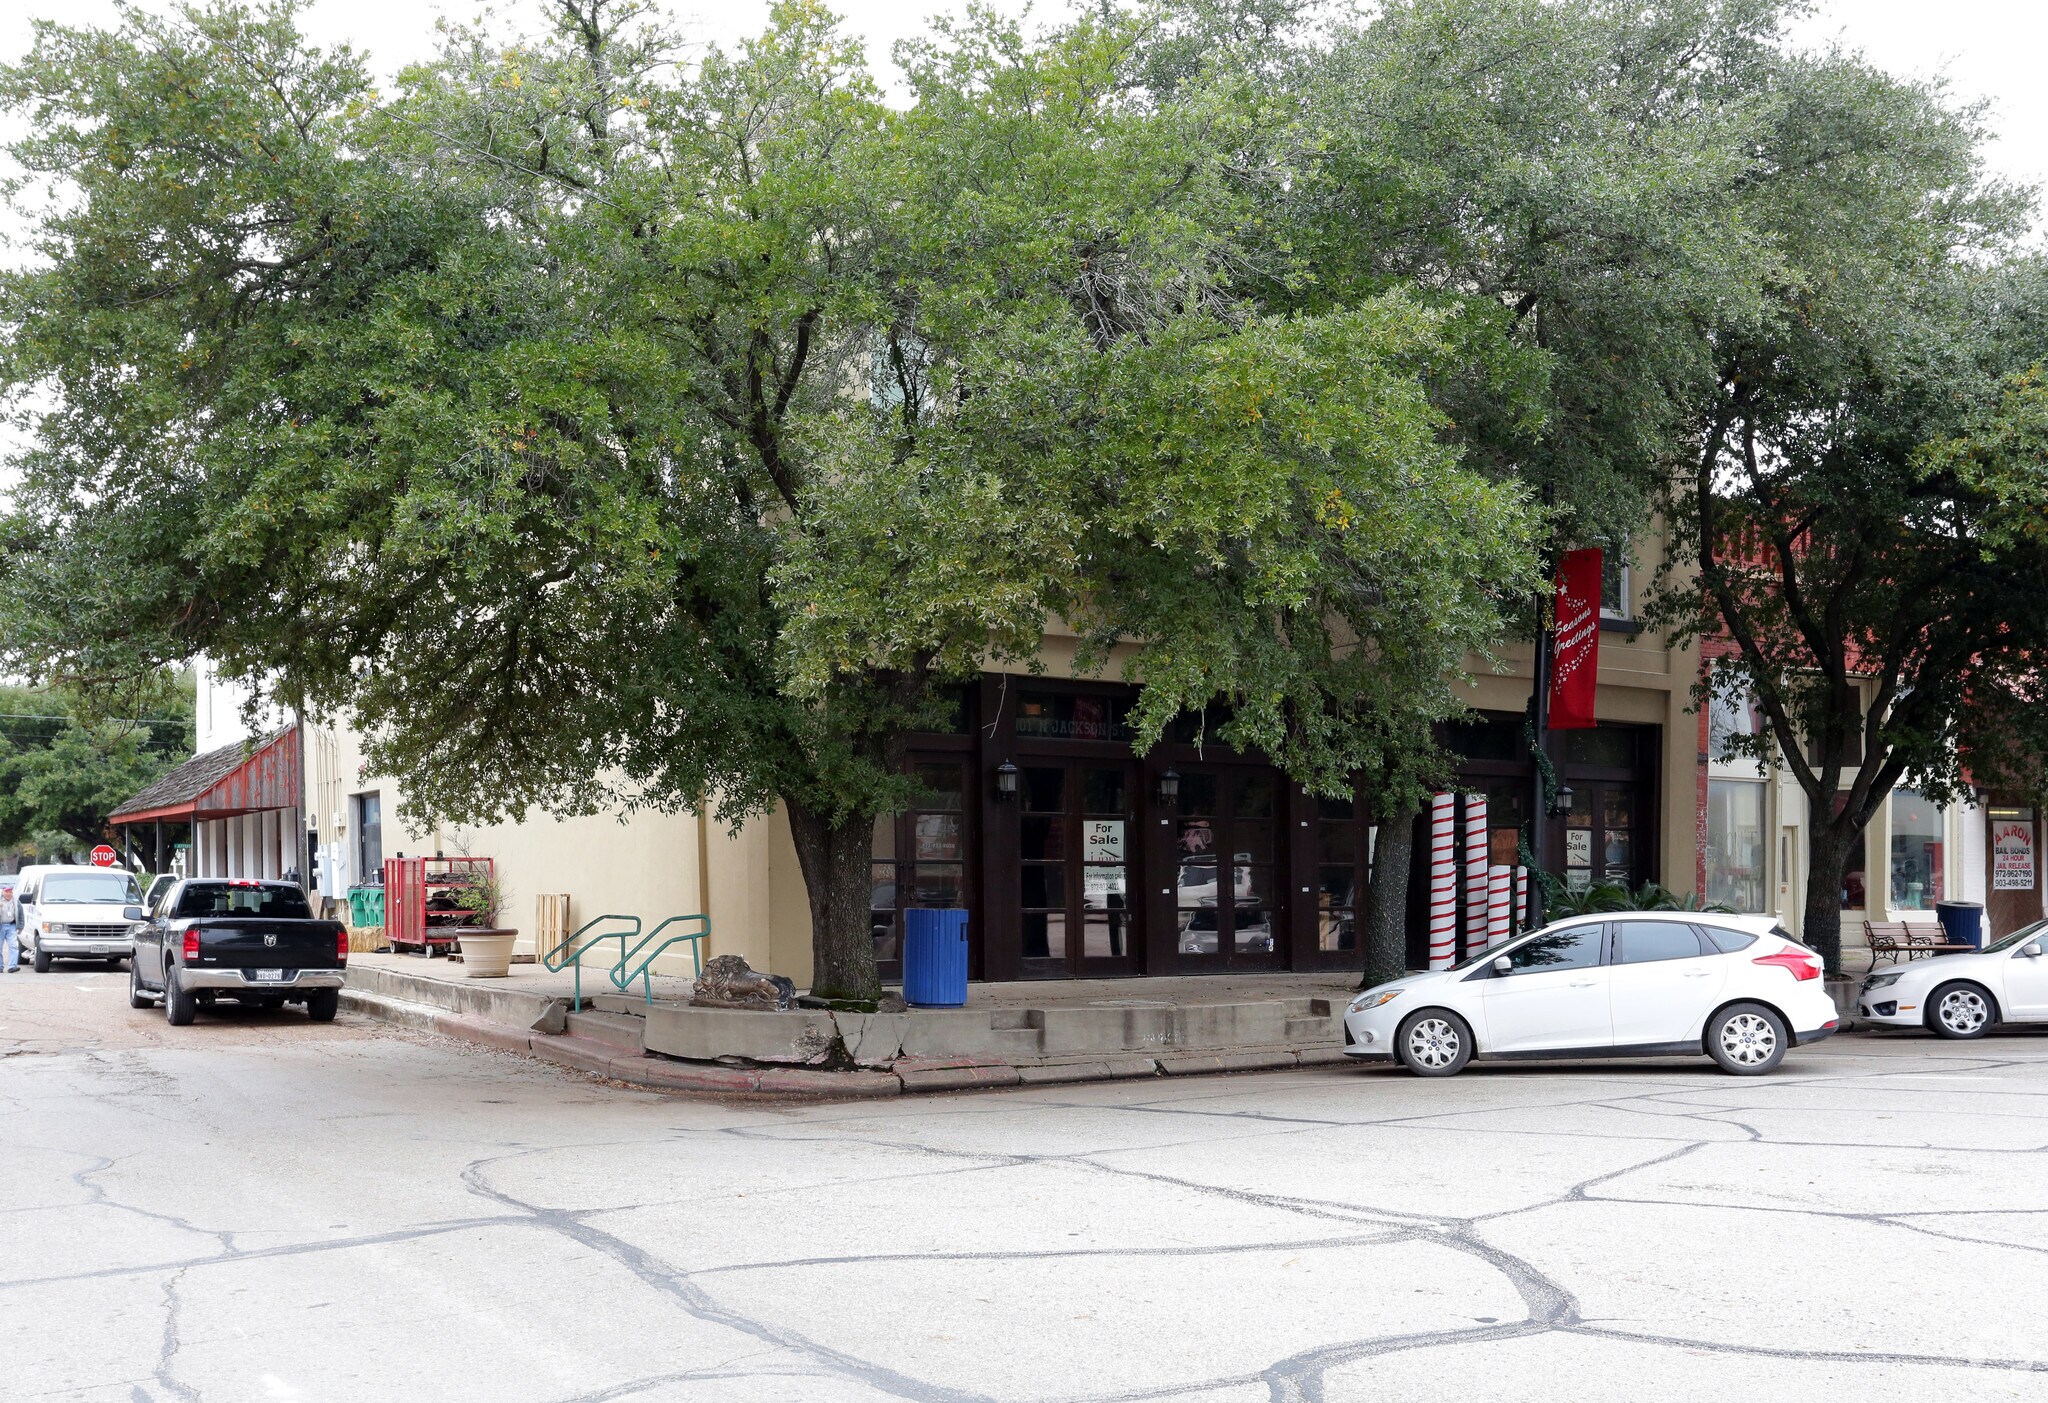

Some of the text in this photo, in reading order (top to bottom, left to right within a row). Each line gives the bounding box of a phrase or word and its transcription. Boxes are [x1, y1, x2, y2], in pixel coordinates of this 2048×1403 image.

[1555, 607, 1592, 637] Seasons
[1554, 621, 1597, 659] Greetings
[1051, 719, 1108, 737] JACKSON
[1095, 823, 1113, 833] For
[1089, 834, 1119, 845] Sale
[1570, 832, 1583, 841] For
[1995, 825, 2031, 846] AARON
[1566, 842, 1587, 851] Sale
[92, 852, 115, 861] STOP
